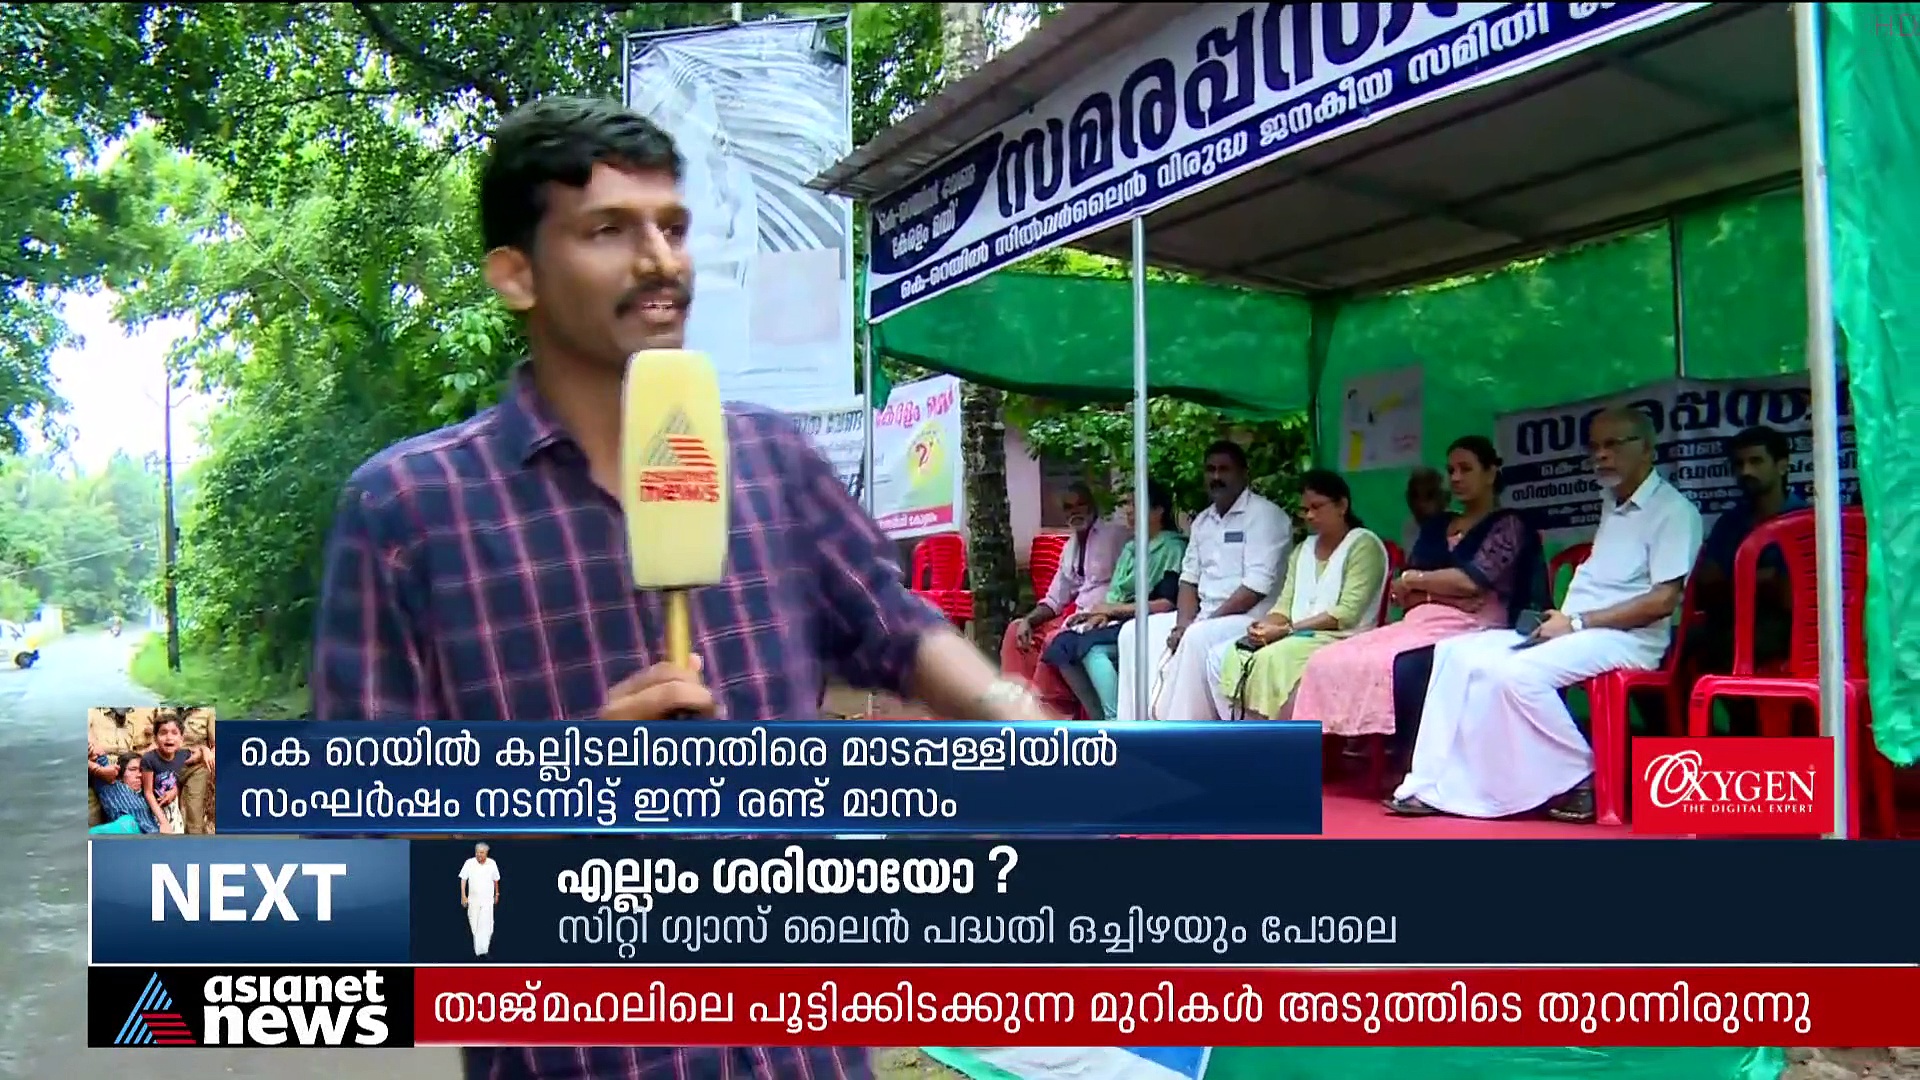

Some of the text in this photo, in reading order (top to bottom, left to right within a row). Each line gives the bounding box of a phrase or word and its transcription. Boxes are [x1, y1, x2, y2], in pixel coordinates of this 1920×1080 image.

[900, 2, 1550, 300] കെ-റെയിൽ സിൽവർലൈൻ വിരുദ്ധ ജനകീയ സമിതി
[998, 2, 1459, 218] സമരപ്പന്ത
